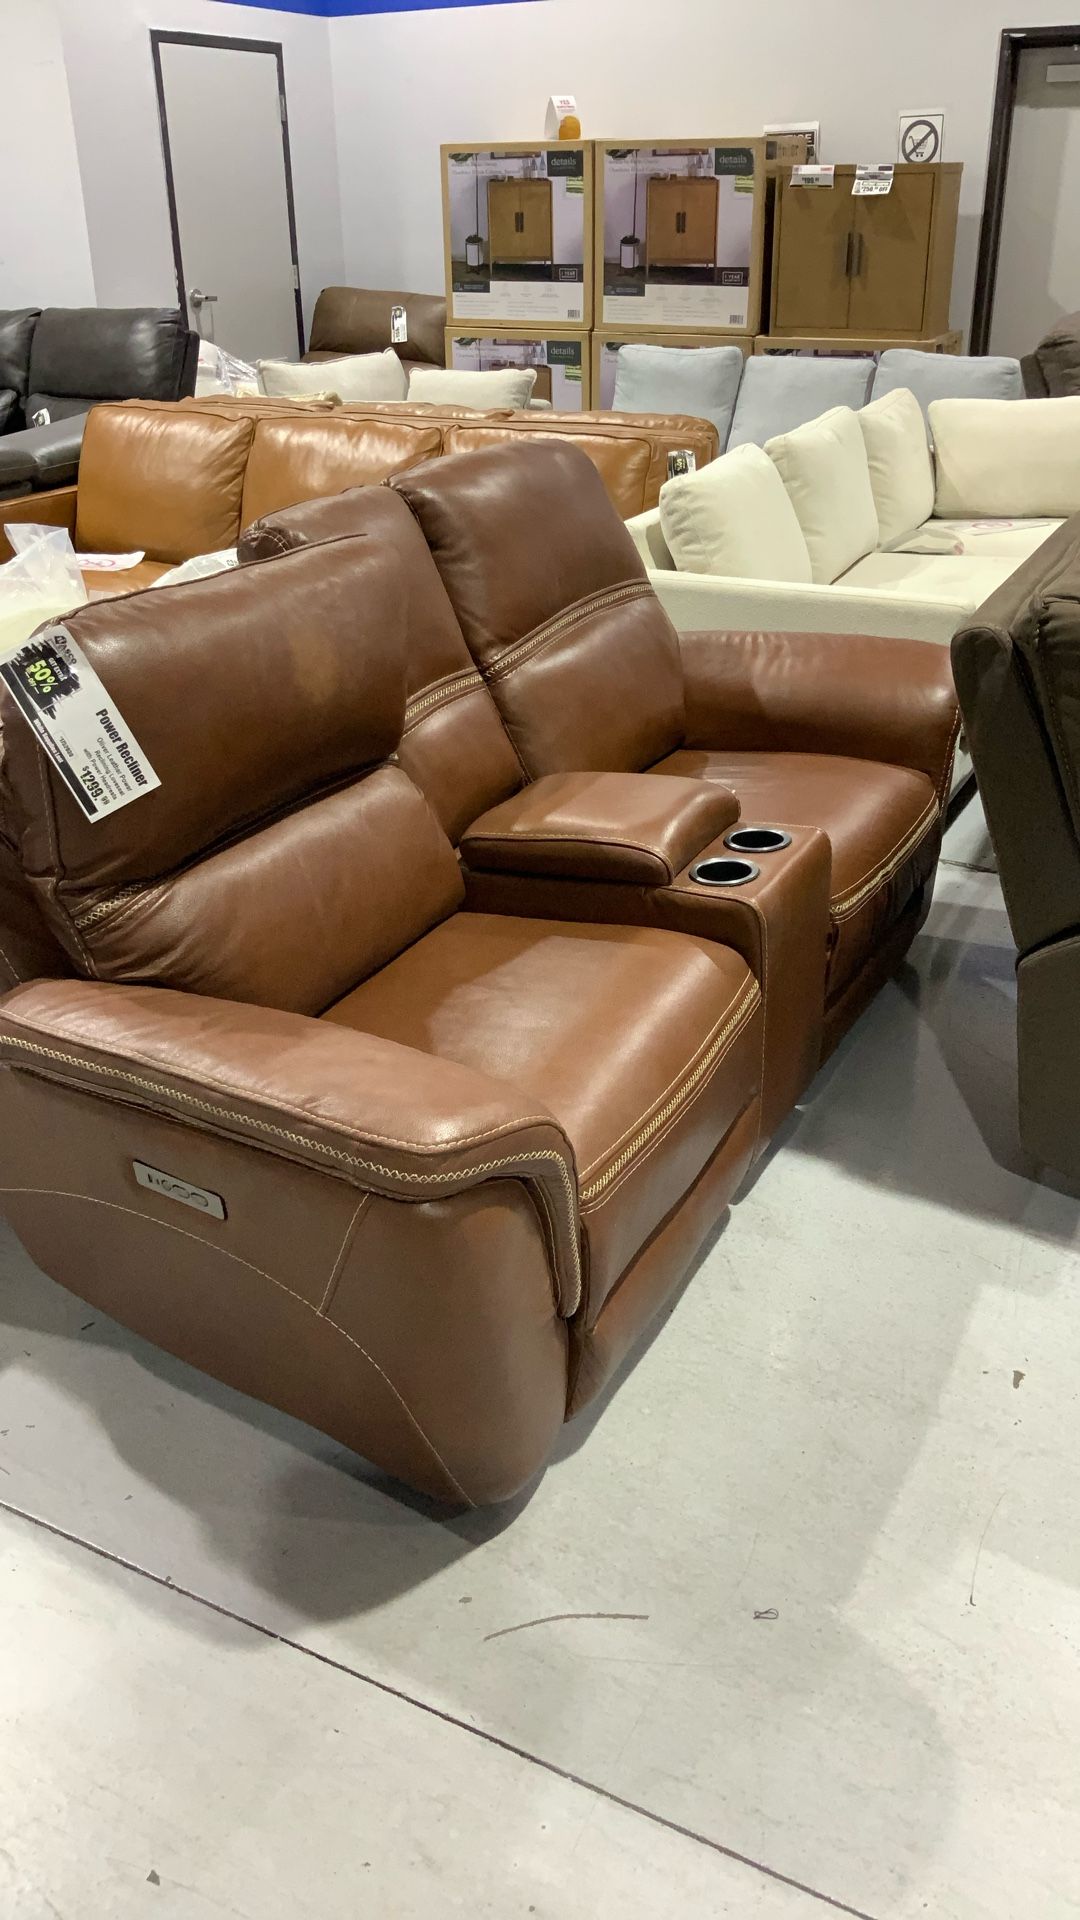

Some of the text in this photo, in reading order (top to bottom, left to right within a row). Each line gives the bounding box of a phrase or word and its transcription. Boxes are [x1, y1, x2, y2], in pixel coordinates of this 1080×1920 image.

[551, 156, 577, 166] details
[719, 154, 748, 165] details
[550, 346, 576, 356] details
[27, 659, 58, 693] 50%
[27, 677, 37, 687] OFF
[47, 657, 67, 682] GET EXTRA
[95, 707, 148, 786] Power Recliner
[83, 748, 117, 800] with Power Headrests
[93, 749, 125, 796] Reclining Loveseat
[96, 736, 133, 791] Oliver Leather Power
